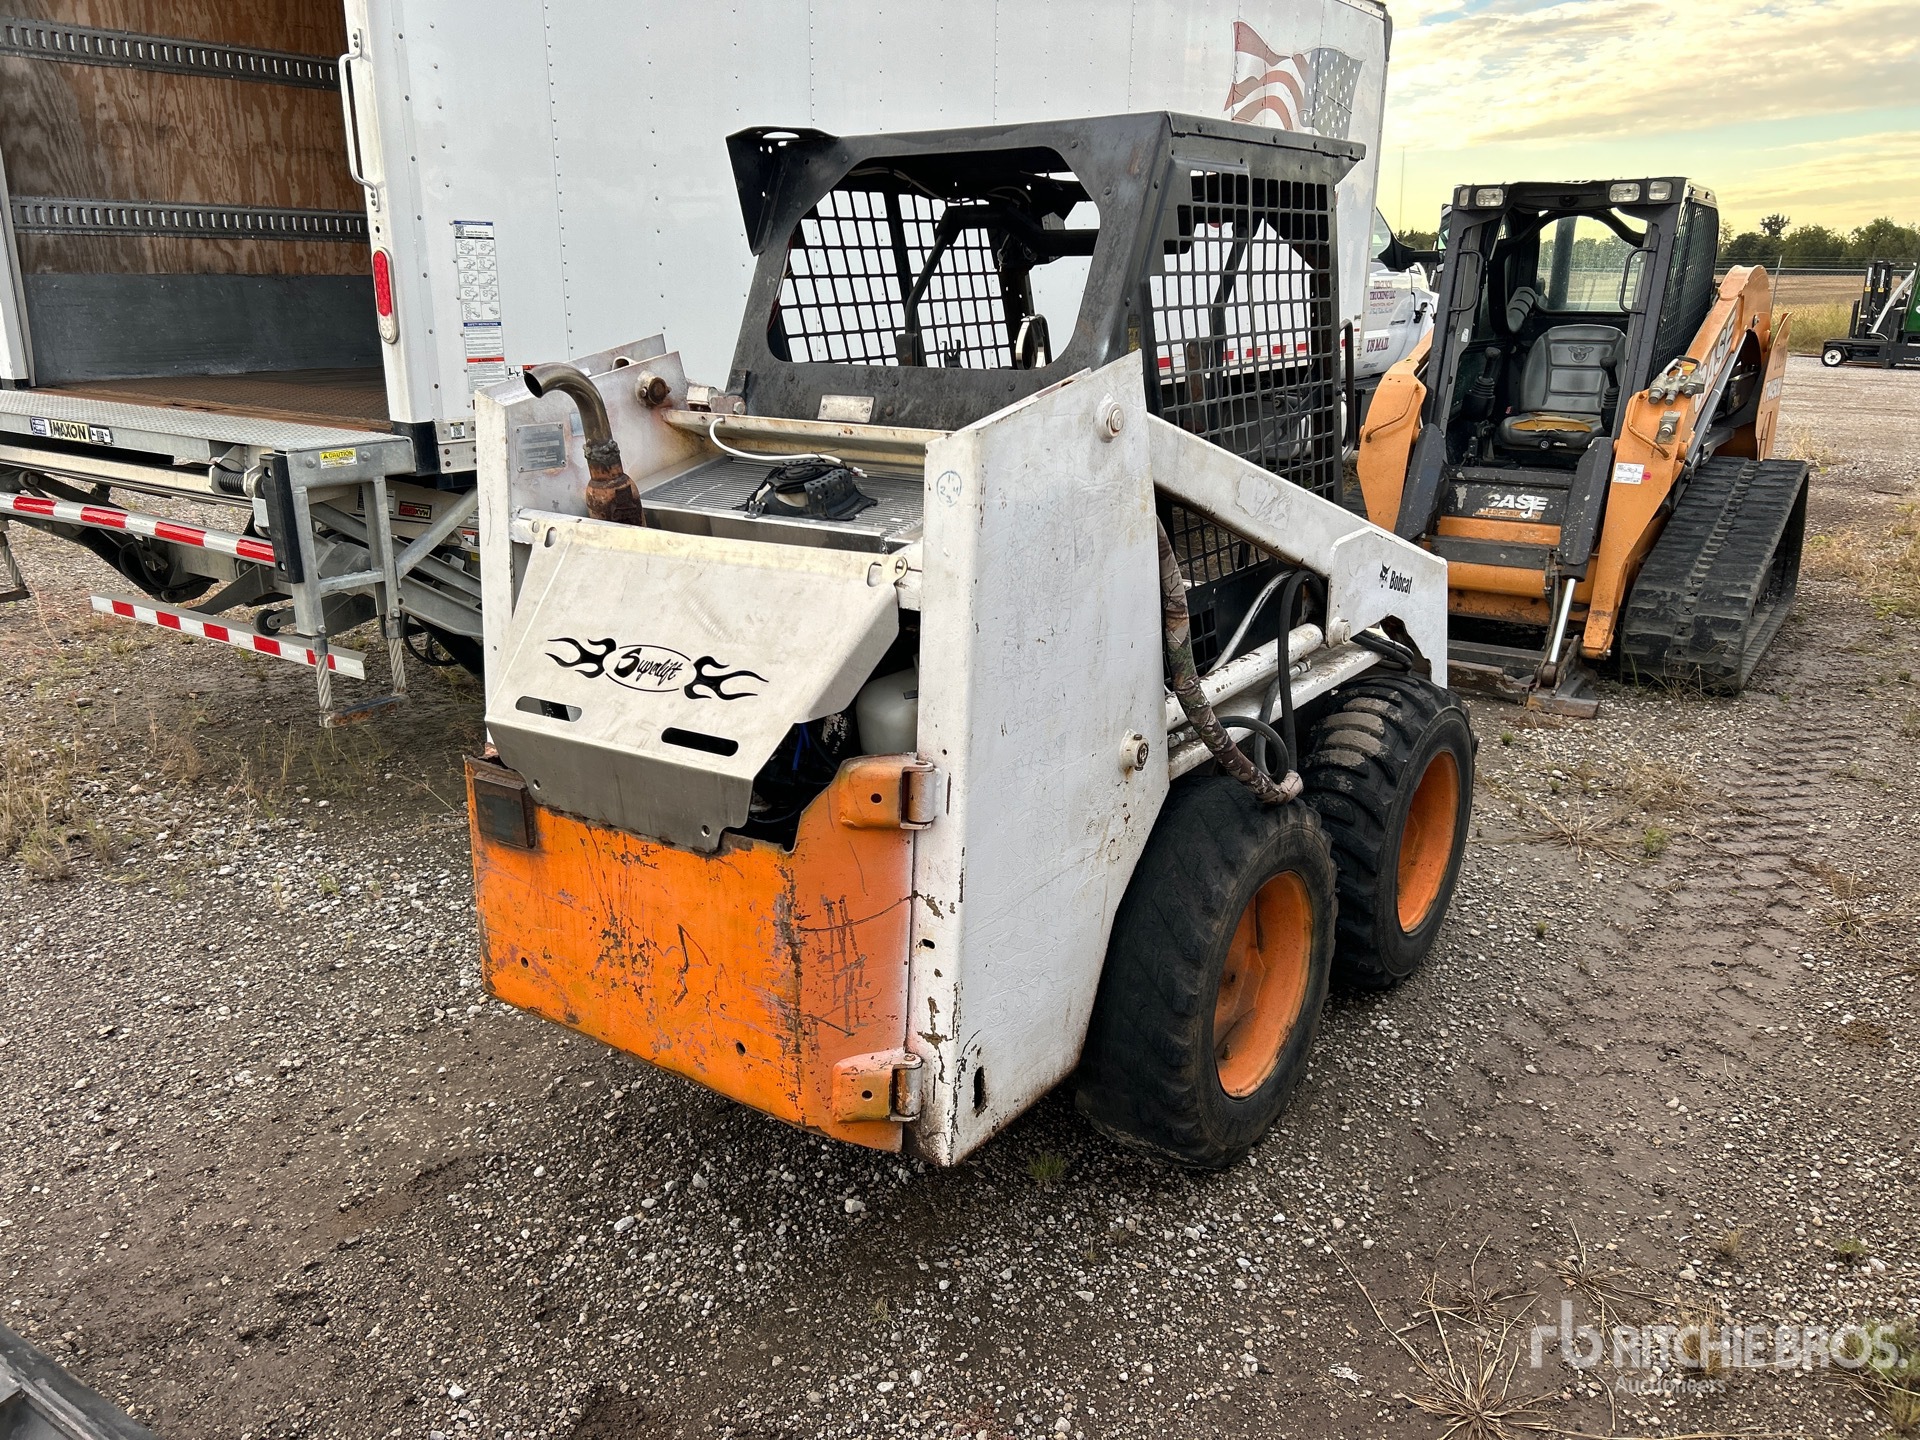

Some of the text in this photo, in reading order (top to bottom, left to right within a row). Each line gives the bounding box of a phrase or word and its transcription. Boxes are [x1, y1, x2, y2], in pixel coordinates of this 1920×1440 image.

[51, 421, 87, 440] MAXON
[328, 450, 354, 459] CAUTION
[1486, 493, 1549, 511] CASE
[1389, 570, 1413, 594] Bobcat
[613, 647, 683, 687] Superlift
